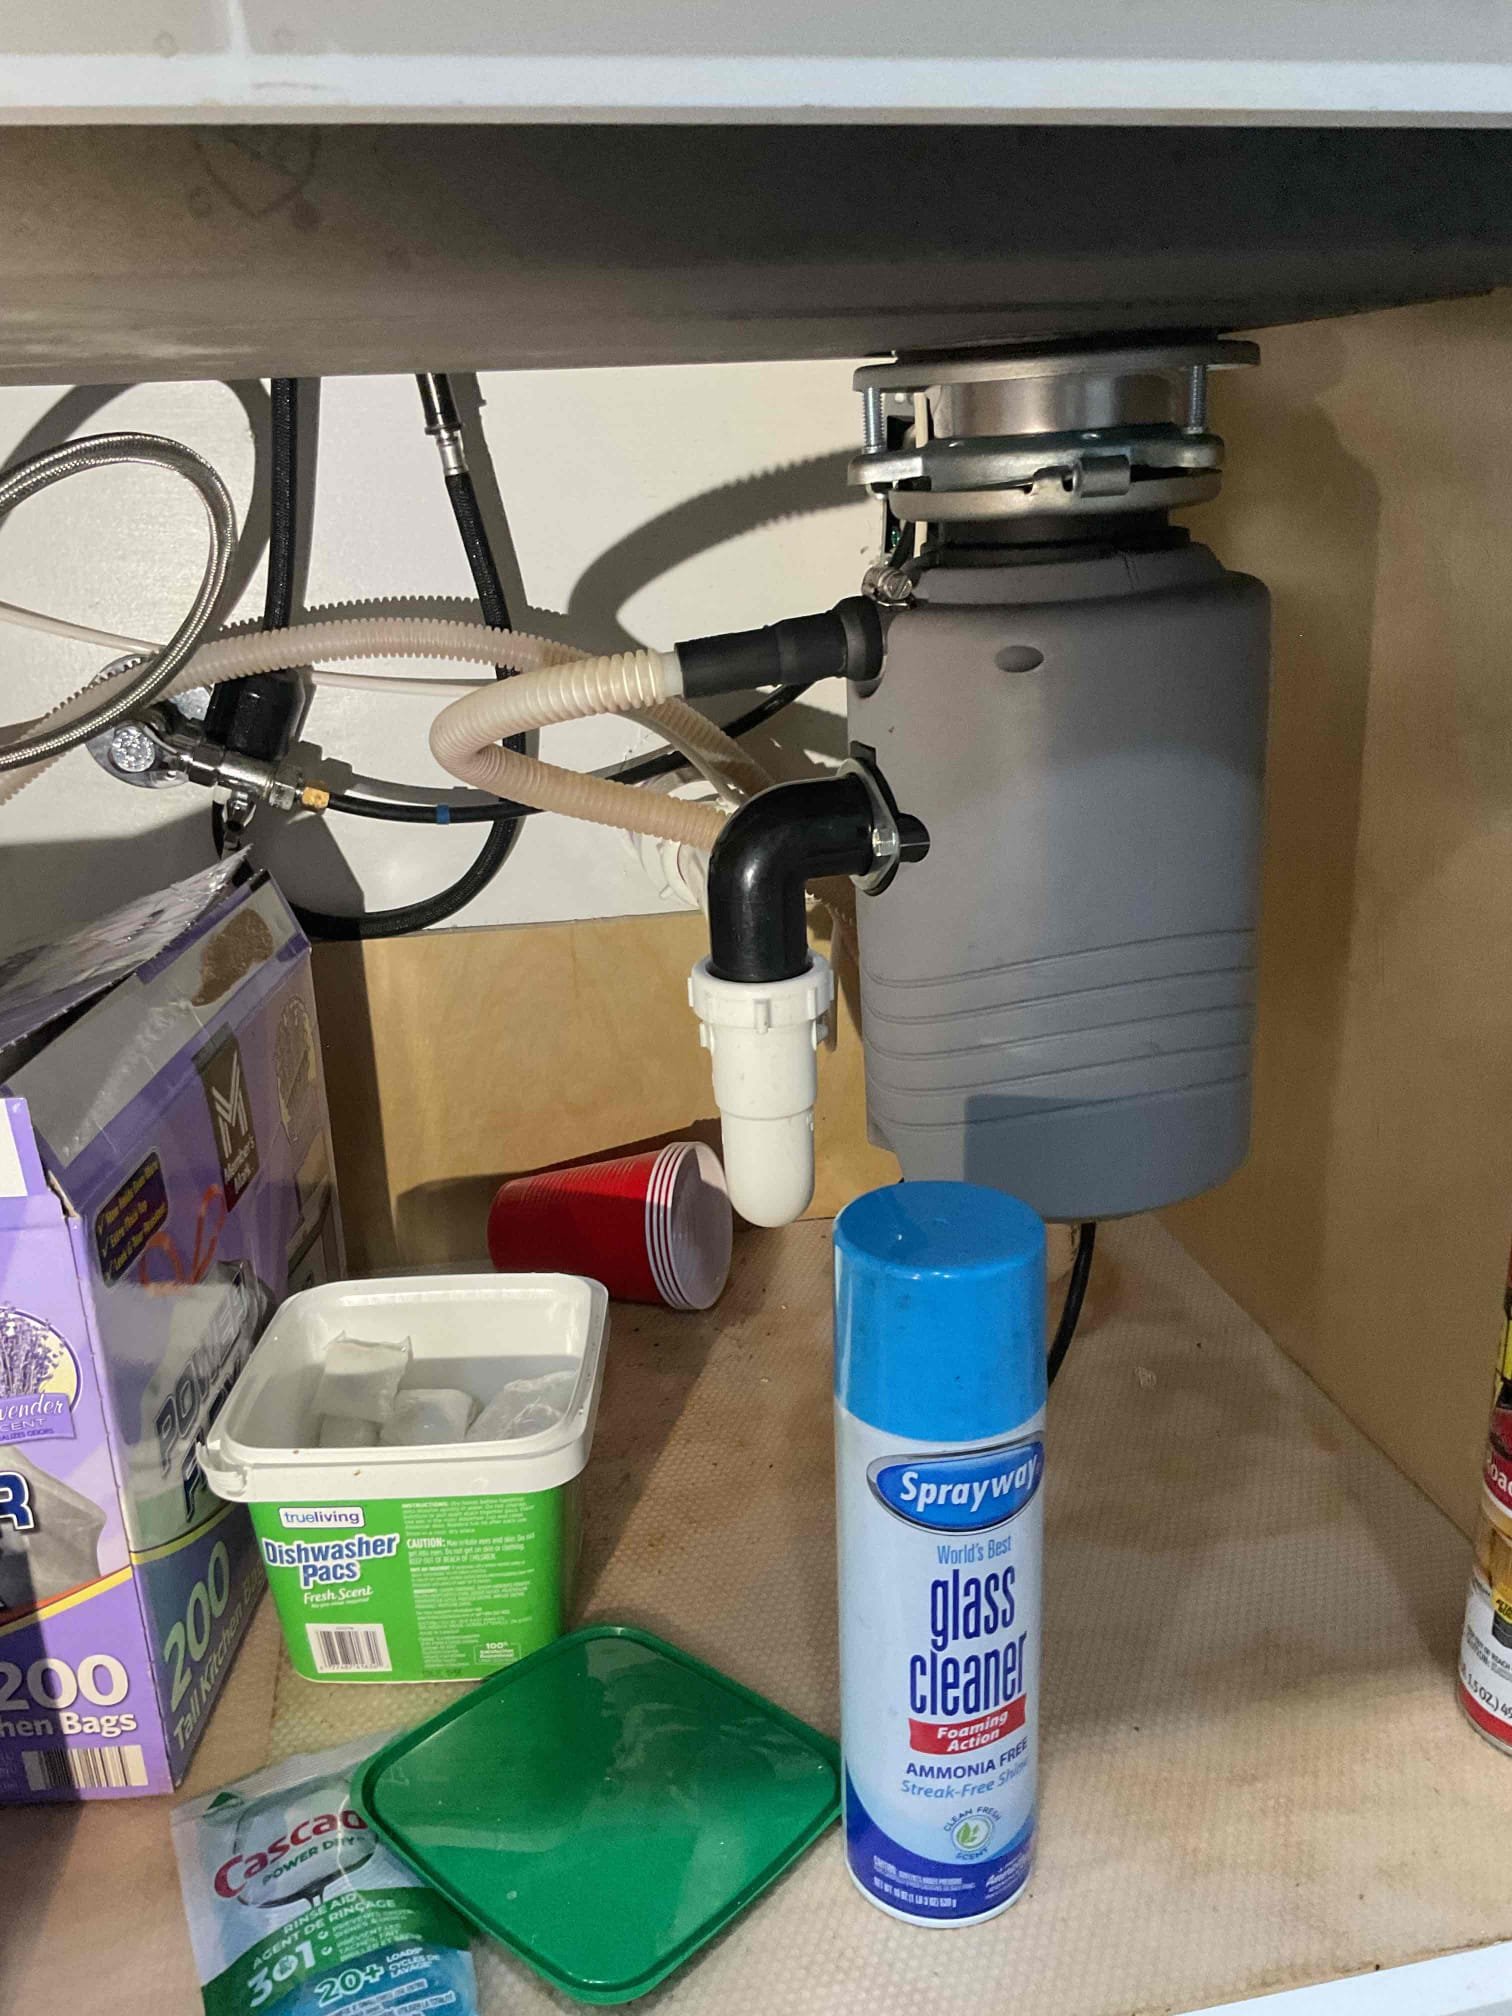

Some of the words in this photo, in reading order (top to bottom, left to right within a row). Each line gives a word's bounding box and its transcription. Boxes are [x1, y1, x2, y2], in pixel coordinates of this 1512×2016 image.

[900, 1454, 1037, 1513] Sprayway
[284, 1511, 360, 1524] trueliving
[263, 1535, 398, 1567] Dishwasher
[407, 1538, 446, 1549] CAUTION:
[937, 1543, 984, 1564] World's
[988, 1536, 1011, 1560] Best
[301, 1562, 359, 1588] Pacs
[304, 1589, 336, 1605] Fresh
[338, 1585, 374, 1600] Scent
[931, 1566, 1015, 1652] glass
[163, 1541, 229, 1712] 200
[0, 1654, 129, 1710] 200
[173, 1688, 200, 1750] Tall
[200, 1602, 243, 1702] Kitchen
[909, 1631, 1027, 1717] cleaner
[59, 1711, 137, 1738] Bags
[937, 1711, 1008, 1739] Foaming
[946, 1729, 1000, 1752] Action
[906, 1760, 996, 1779] AMMONIA
[1000, 1736, 1028, 1767] FREE
[901, 1780, 995, 1799] Streak-Free
[997, 1760, 1028, 1787] Shine
[944, 1808, 972, 1832] CLEAN
[976, 1806, 1001, 1821] FRESH
[262, 1846, 318, 1885] POWER
[955, 1847, 988, 1861] SCENT
[283, 1904, 327, 1934] RINSE
[330, 1892, 357, 1911] AID
[253, 1932, 300, 1970] AGENT
[304, 1919, 326, 1935] DE
[313, 1963, 384, 2008] 20+
